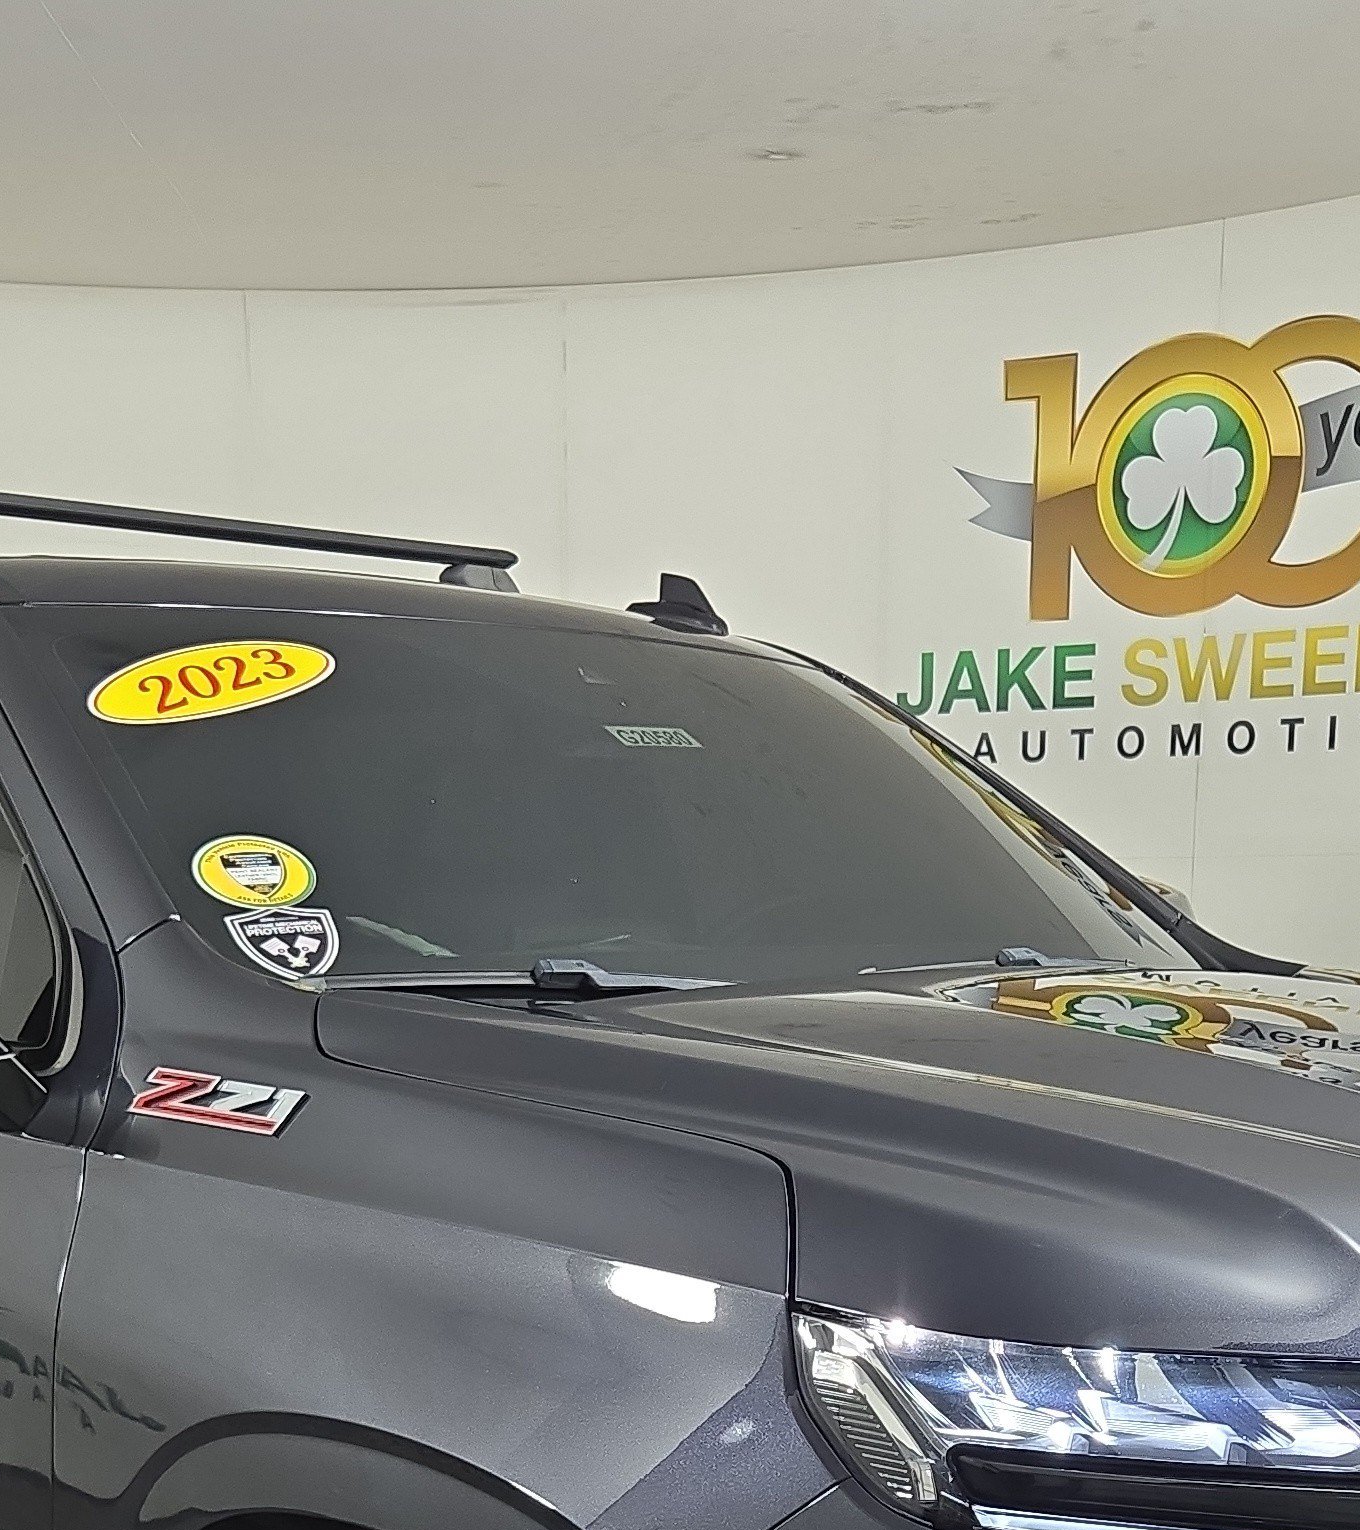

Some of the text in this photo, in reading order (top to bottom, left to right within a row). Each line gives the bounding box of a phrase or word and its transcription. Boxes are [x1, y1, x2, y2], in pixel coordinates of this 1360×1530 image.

[138, 646, 298, 715] 2023
[897, 643, 1097, 717] JAKE
[244, 923, 323, 937] PROTECTION
[126, 1065, 308, 1139] Z71
